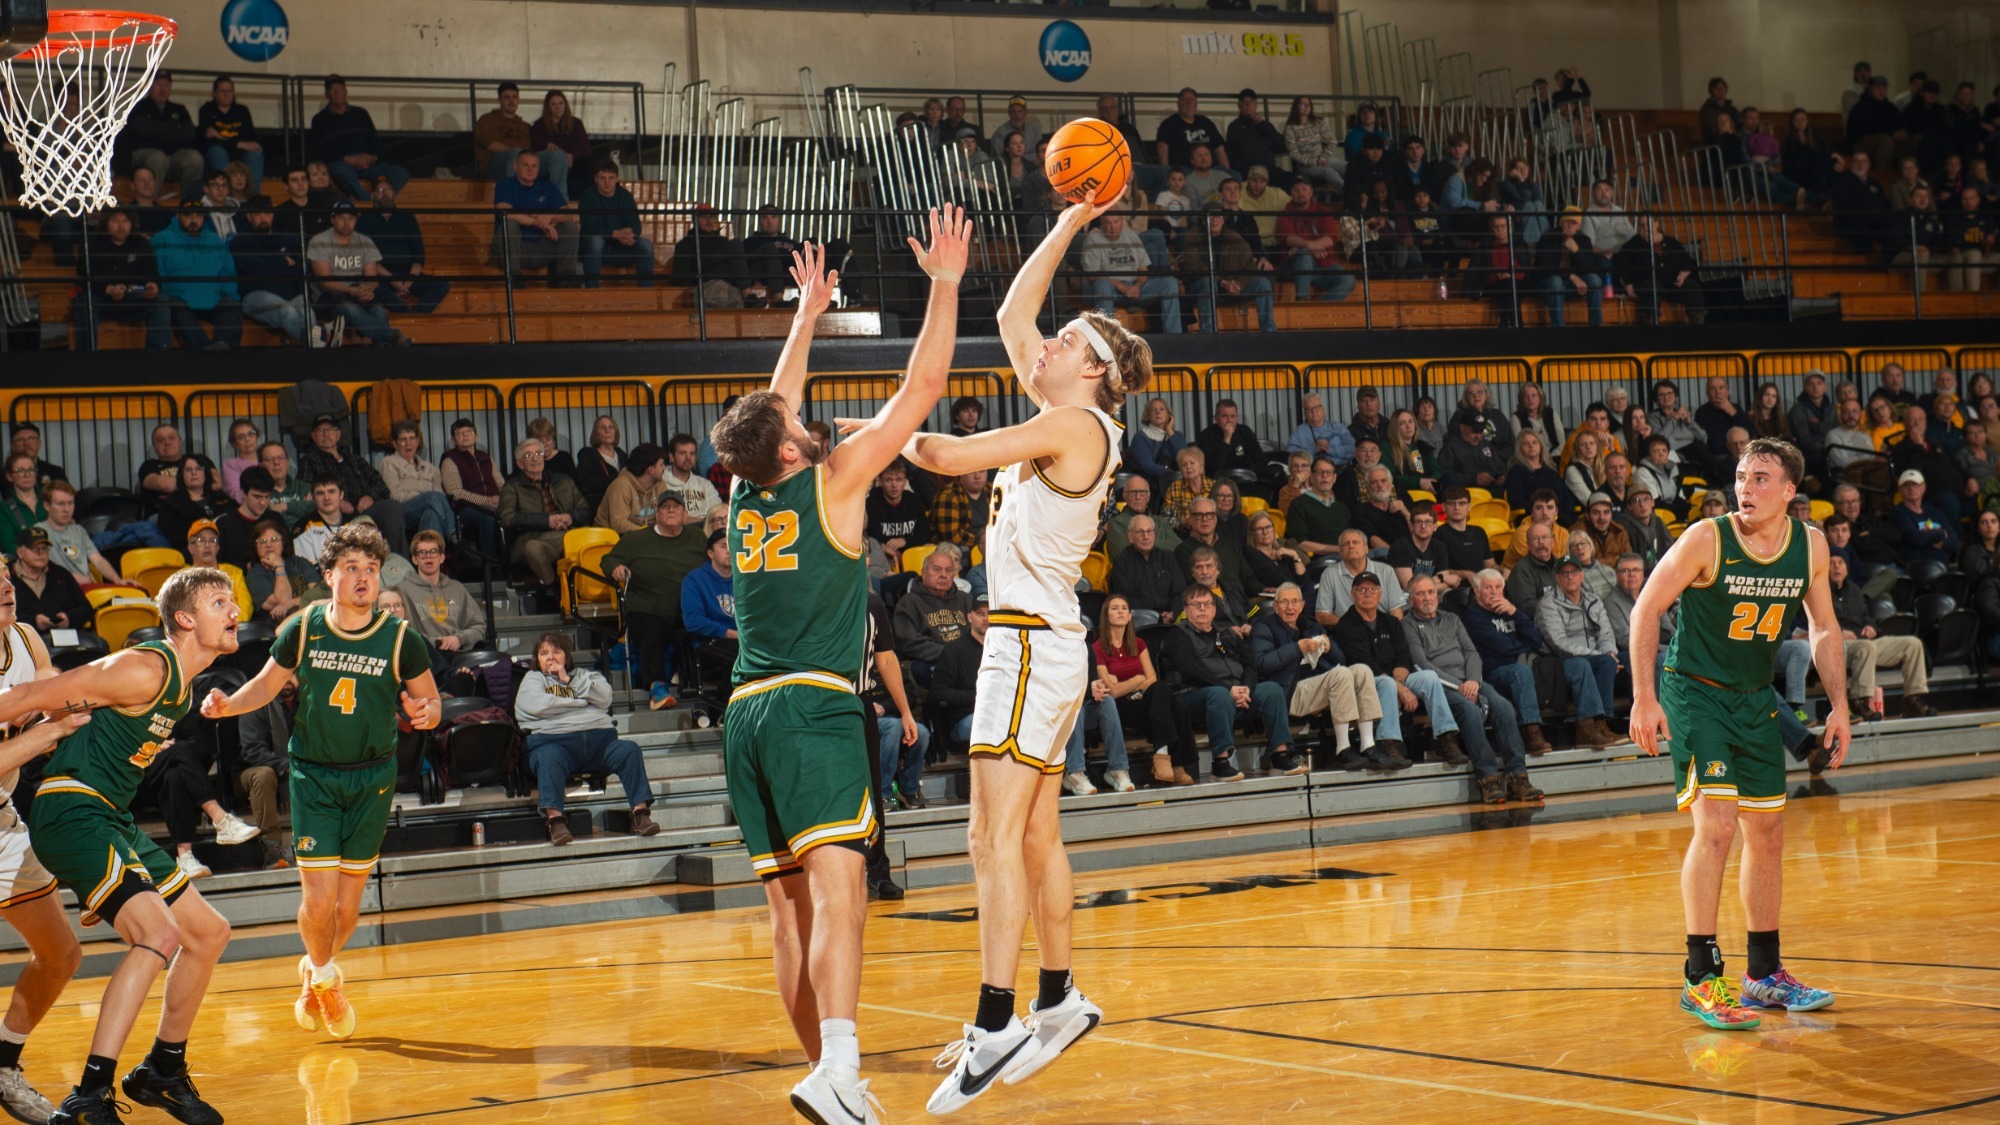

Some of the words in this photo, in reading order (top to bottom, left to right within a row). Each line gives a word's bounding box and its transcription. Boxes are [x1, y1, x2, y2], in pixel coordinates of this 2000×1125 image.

[227, 25, 289, 45] NCAA
[1181, 31, 1235, 54] mix
[1242, 33, 1304, 56] 93.5
[1044, 50, 1091, 67] NCAA
[736, 508, 799, 573] 32
[1723, 574, 1804, 588] NORTHERN
[1727, 584, 1801, 598] MICHIGAN
[1727, 601, 1786, 641] 24
[309, 649, 387, 668] NORTHERN
[311, 659, 385, 677] MICHIGAN
[329, 677, 357, 715] 4
